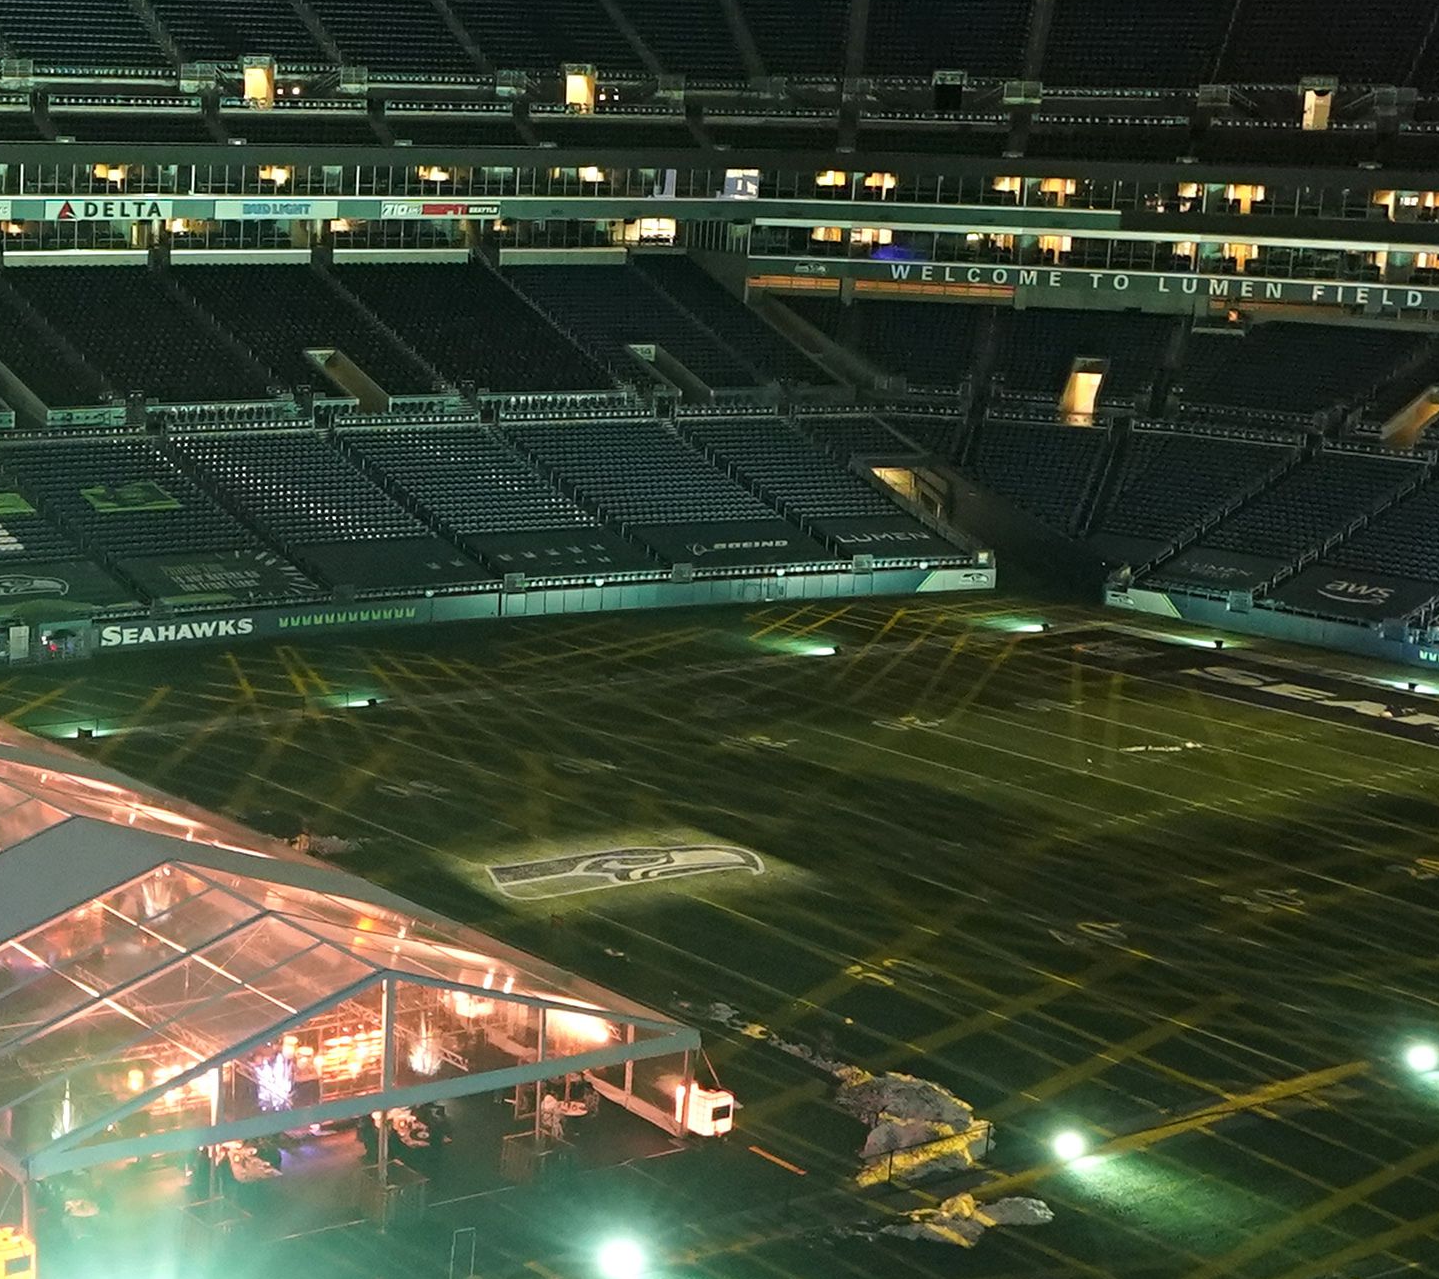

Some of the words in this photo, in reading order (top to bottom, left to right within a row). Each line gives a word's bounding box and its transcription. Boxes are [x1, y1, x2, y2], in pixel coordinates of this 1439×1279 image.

[84, 202, 162, 218] DELTA
[242, 203, 272, 215] BUD
[275, 203, 312, 215] LIGHT
[381, 204, 407, 216] 710
[890, 263, 1062, 287] WELCOME
[1090, 272, 1130, 291] TO
[1158, 276, 1283, 300] LUMEN
[1311, 284, 1424, 307] FIELD
[1324, 578, 1397, 599] aws
[99, 618, 254, 648] SEAHAWKS
